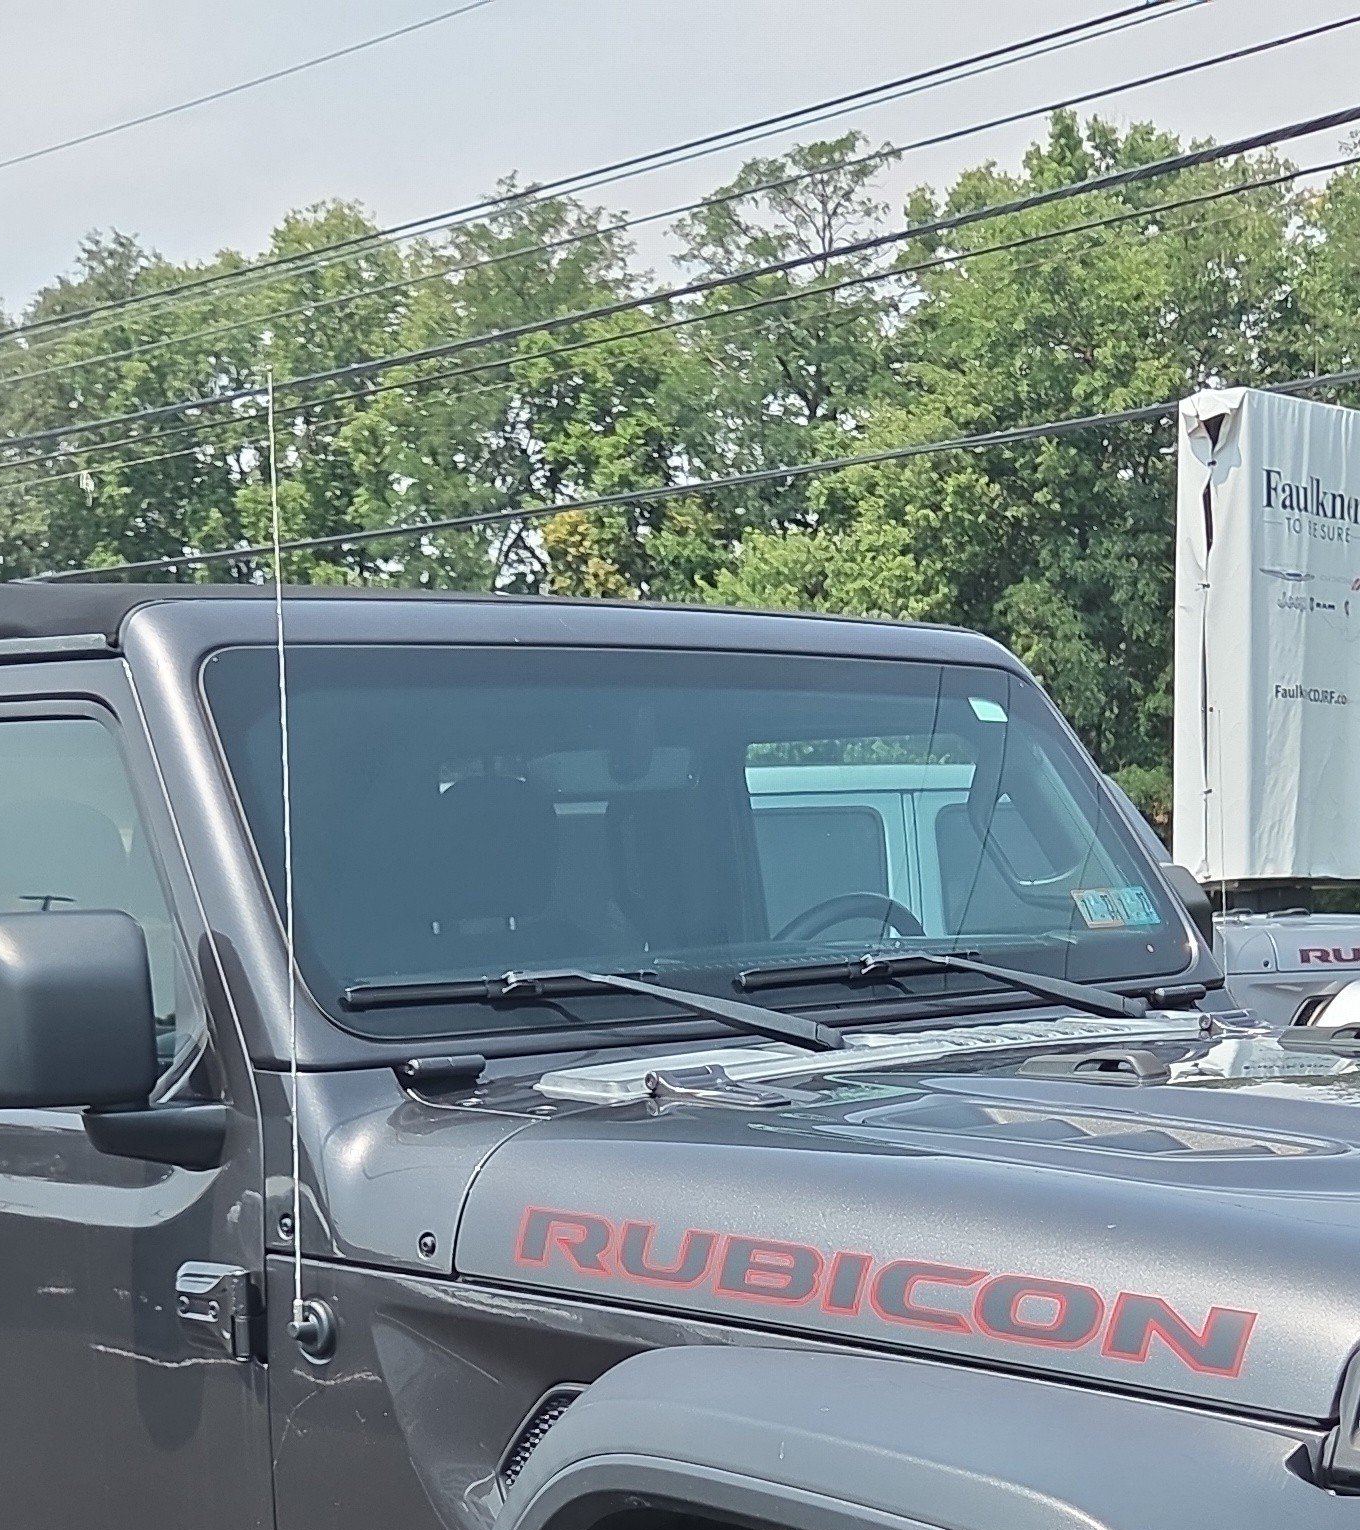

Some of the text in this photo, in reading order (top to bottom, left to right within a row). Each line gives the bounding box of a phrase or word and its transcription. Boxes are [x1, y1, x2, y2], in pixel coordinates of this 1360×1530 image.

[1285, 517, 1302, 534] TO
[1320, 524, 1351, 543] SURE
[1315, 602, 1336, 610] RAM
[514, 1205, 1259, 1379] RUBICON
